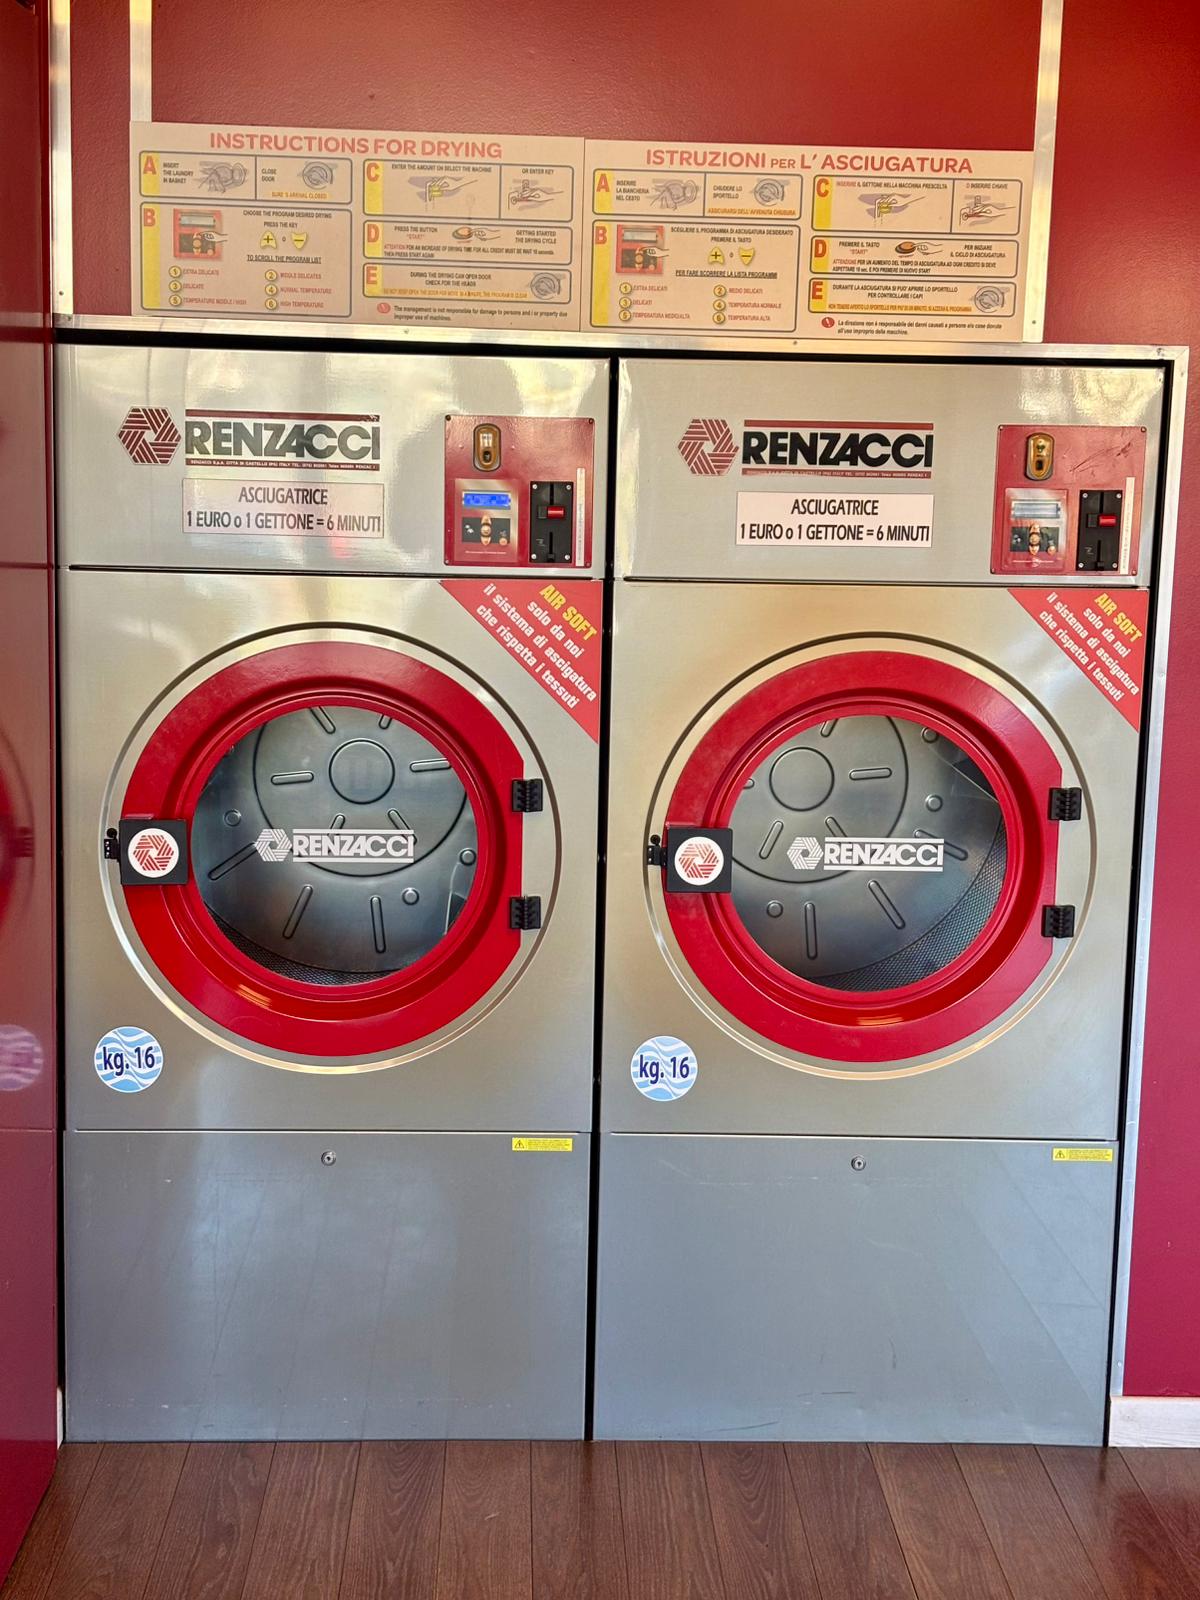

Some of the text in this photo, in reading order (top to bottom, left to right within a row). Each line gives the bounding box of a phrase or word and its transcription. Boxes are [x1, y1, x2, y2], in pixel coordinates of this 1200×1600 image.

[210, 132, 501, 159] INSTRUCTIONS FOR DRYING
[143, 156, 156, 175] A
[646, 149, 766, 168] ISTRUZIONI
[770, 158, 795, 168] PER
[366, 162, 380, 182] C
[596, 173, 610, 193] A
[816, 178, 829, 198] C
[143, 208, 156, 226] B
[367, 224, 379, 242] D
[595, 226, 607, 244] B
[814, 239, 827, 257] D
[366, 266, 377, 284] E
[700, 270, 725, 278] SCORRERE
[812, 281, 823, 300] E
[184, 420, 380, 460] RENZACCI
[742, 430, 934, 468] RENZACCI
[238, 486, 328, 505] ASCIUGATRICE
[791, 499, 879, 516] ASCIUGATRICE
[186, 510, 381, 533] 1 EURO o 1 GETTONE = 6 MINUTI
[740, 523, 930, 542] 1 EURO o 1 GETTONE = 6 MINUTI
[539, 584, 598, 641] AIR SOFT
[1094, 593, 1143, 643] AIR SOFT
[526, 601, 585, 659] solo da noi
[1083, 608, 1131, 658] solo da noi
[476, 604, 580, 709] che rispetta i tessuti
[493, 594, 535, 637] sistema
[532, 634, 548, 648] di
[544, 647, 597, 701] ascigatura
[1039, 610, 1124, 701] che rispetta i tessuti
[1054, 601, 1088, 639] sistema
[1086, 637, 1101, 649] di
[1096, 647, 1140, 696] ascigatura
[293, 835, 414, 857] RENZACCI
[824, 843, 944, 866] RENZACCI
[103, 1046, 155, 1076] kg. 16
[639, 1054, 690, 1085] kg. 16
